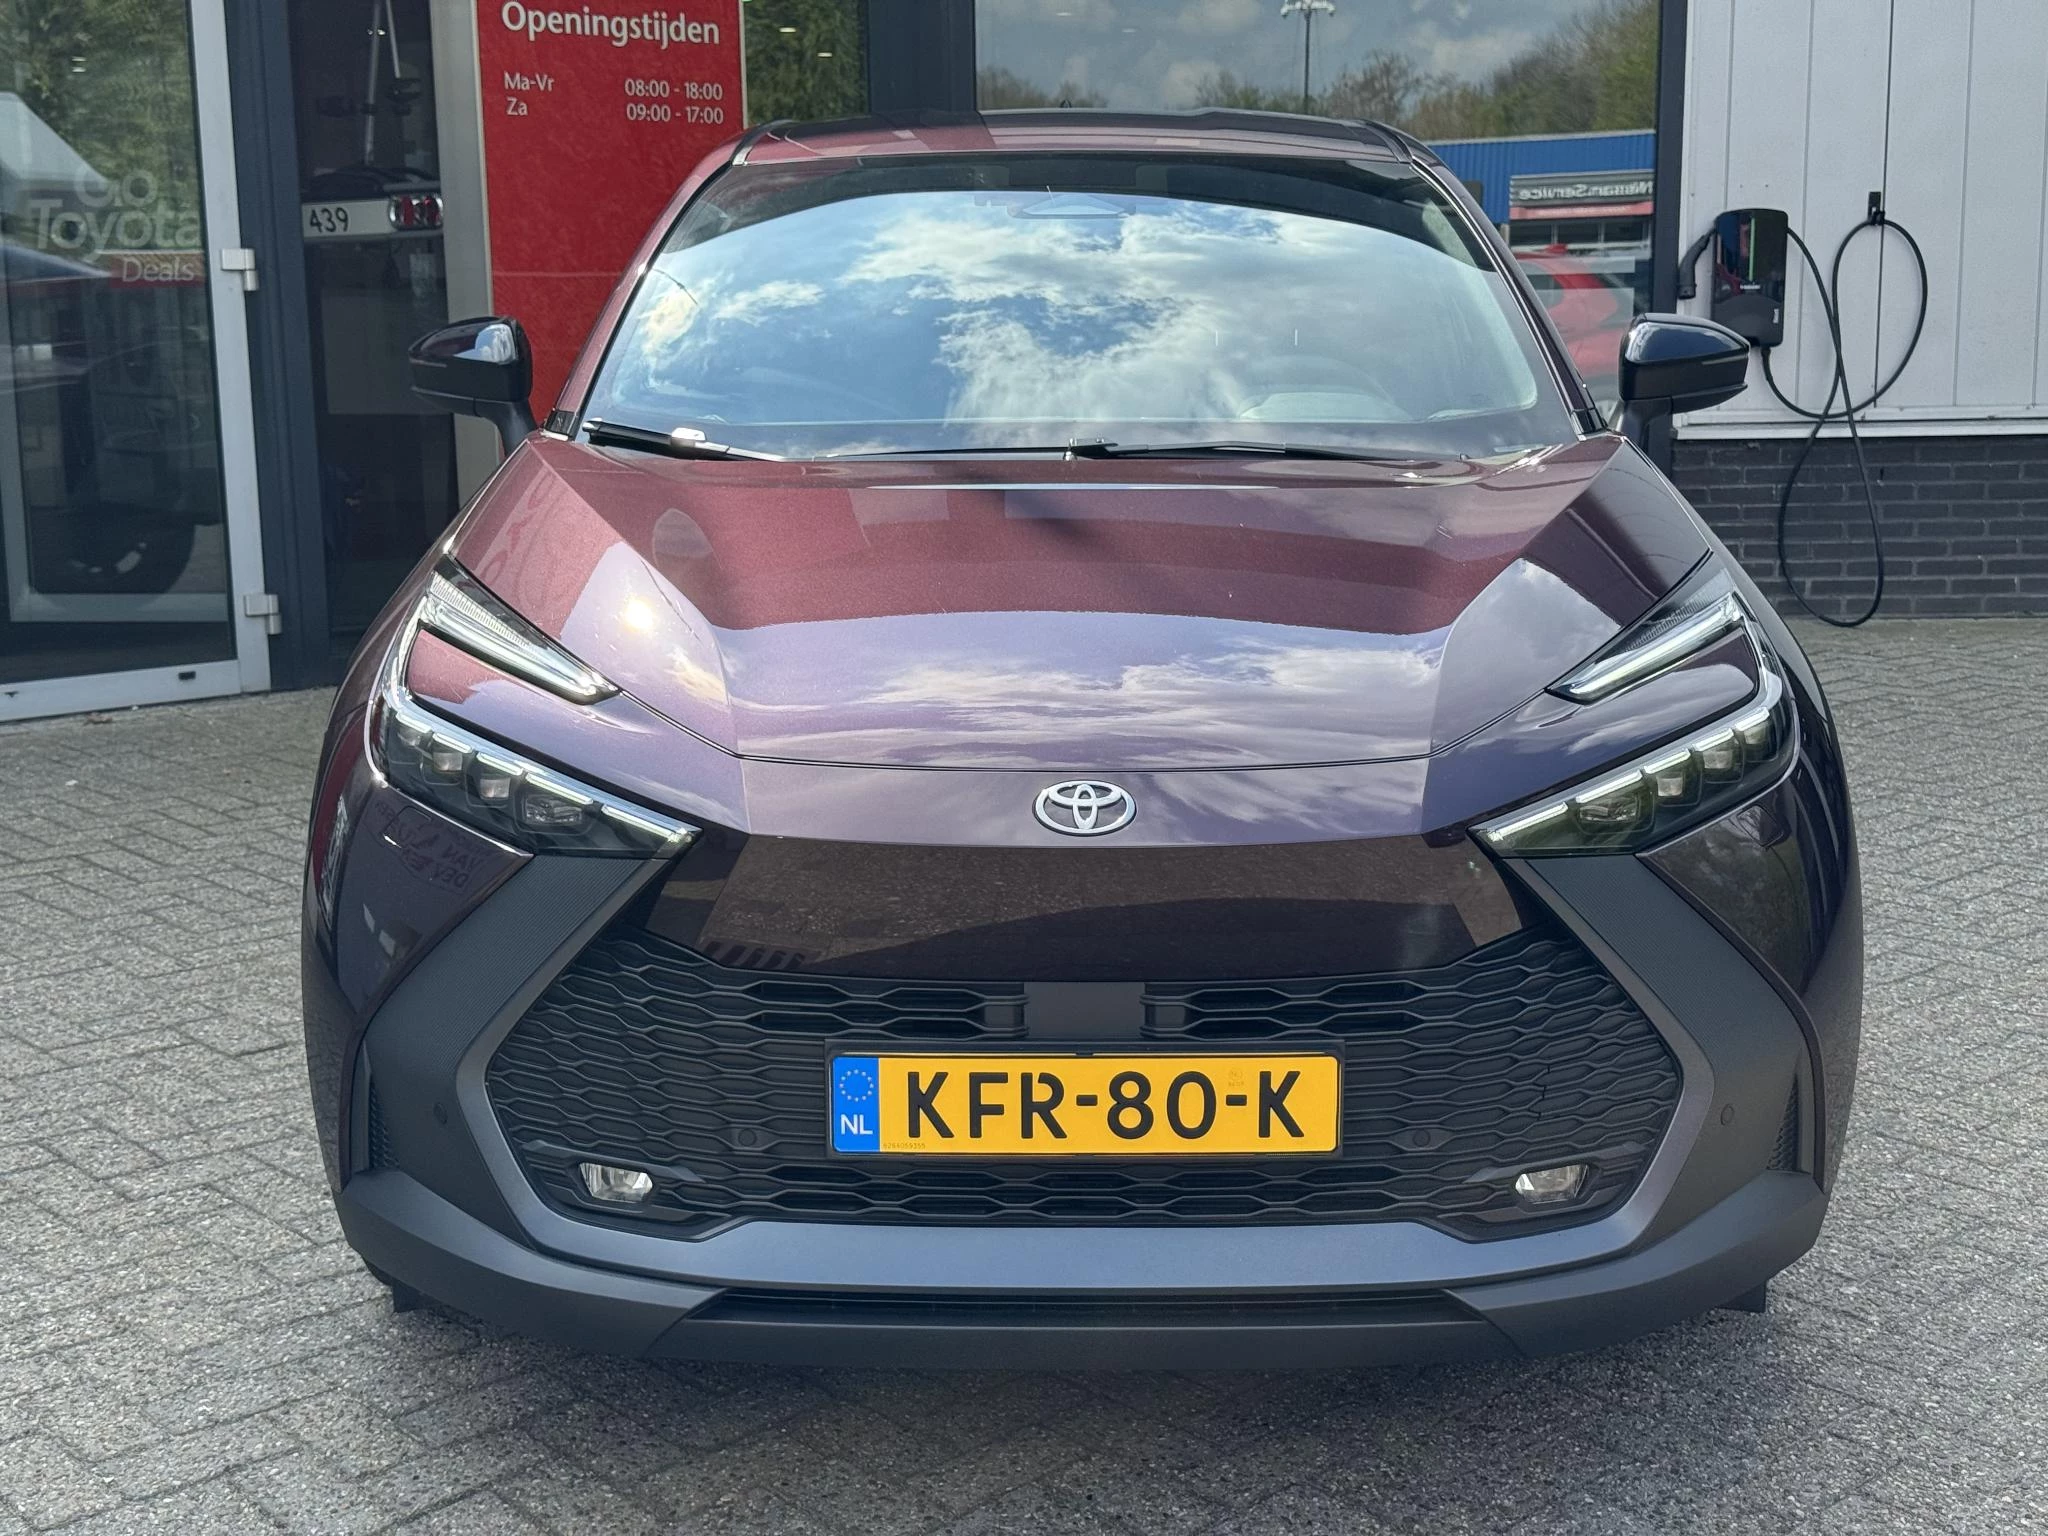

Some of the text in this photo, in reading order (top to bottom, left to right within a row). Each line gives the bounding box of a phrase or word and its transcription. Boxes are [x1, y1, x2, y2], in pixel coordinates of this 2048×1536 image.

[501, 1, 720, 50] Openingstijden
[503, 71, 555, 92] Ma-Vr
[624, 78, 670, 97] 08:00
[685, 81, 723, 101] 18:00
[506, 96, 528, 116] Za
[626, 103, 671, 122] 09:00
[686, 105, 724, 125] 17:00
[28, 199, 201, 265] Toyota
[309, 207, 349, 233] 439
[121, 256, 195, 282] Deals
[906, 1070, 1305, 1139] KFR-80-K
[840, 1115, 873, 1135] NL
